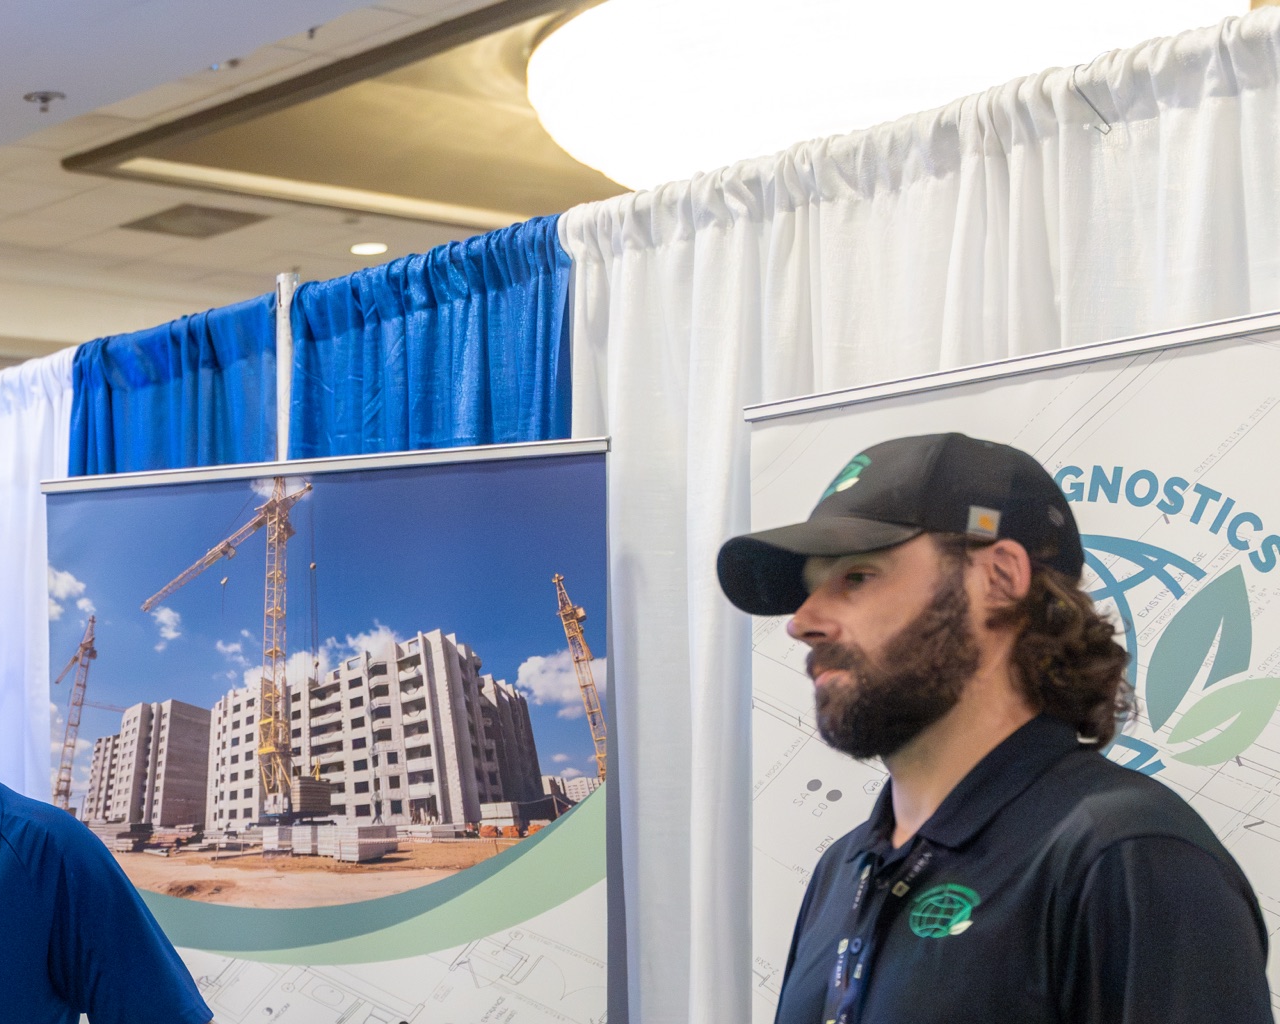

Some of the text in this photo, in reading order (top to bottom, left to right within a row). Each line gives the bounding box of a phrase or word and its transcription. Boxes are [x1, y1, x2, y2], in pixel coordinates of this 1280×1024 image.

[1053, 465, 1280, 574] GNOSTICS
[1137, 588, 1170, 618] EXISTIN
[1174, 551, 1207, 583] GAGE
